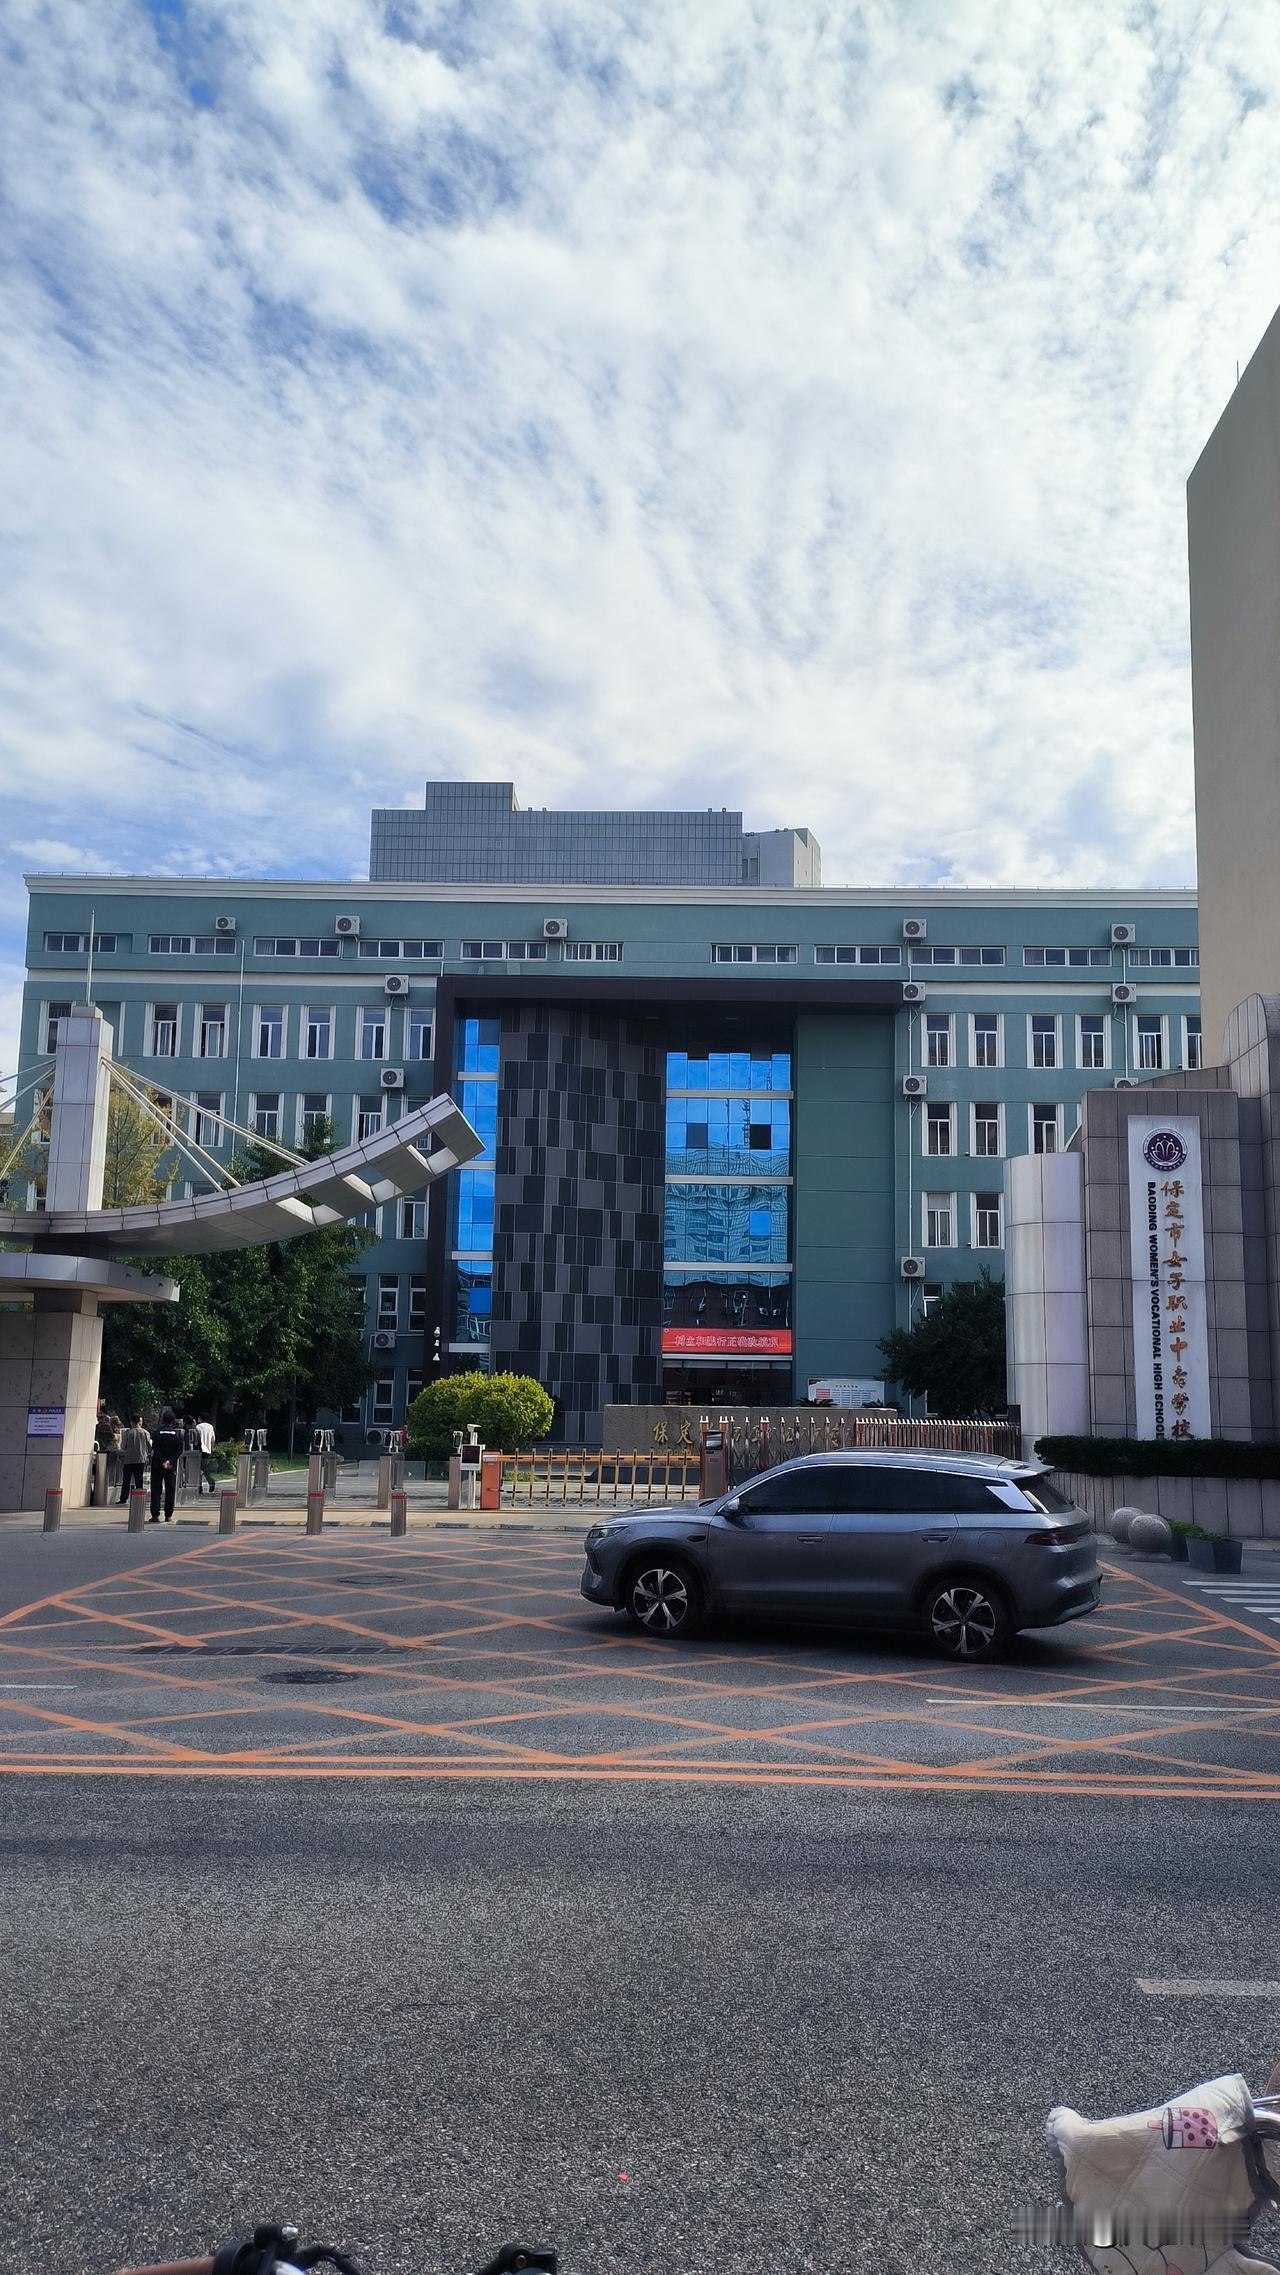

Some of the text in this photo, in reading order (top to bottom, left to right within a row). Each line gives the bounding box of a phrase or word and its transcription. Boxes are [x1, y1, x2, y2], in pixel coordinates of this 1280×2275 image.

[1147, 1181, 1165, 1439] BAODING WOMEN'S VOCATIONAL HIGH SCHOOL
[1160, 1180, 1194, 1439] 保定市女子职业中专学校
